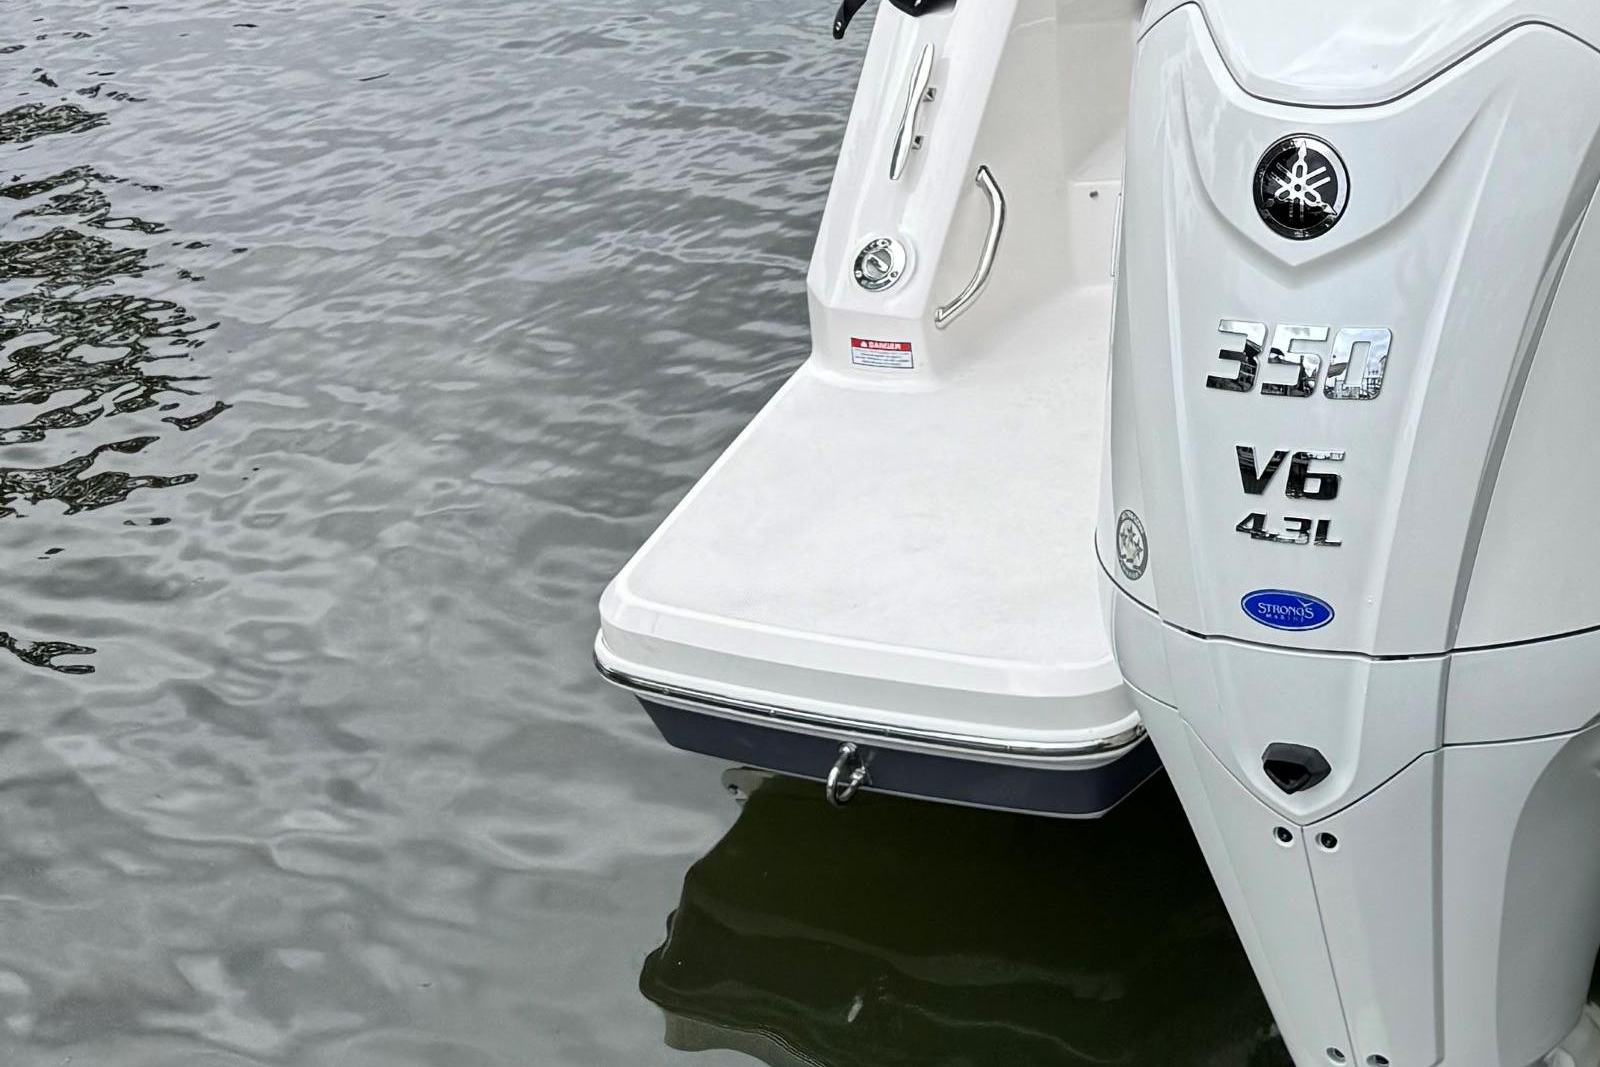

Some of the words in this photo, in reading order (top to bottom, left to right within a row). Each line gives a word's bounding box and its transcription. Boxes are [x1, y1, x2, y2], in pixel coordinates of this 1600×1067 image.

[1205, 319, 1393, 401] 350
[1236, 444, 1346, 501] V6
[1235, 511, 1343, 547] 4.3L
